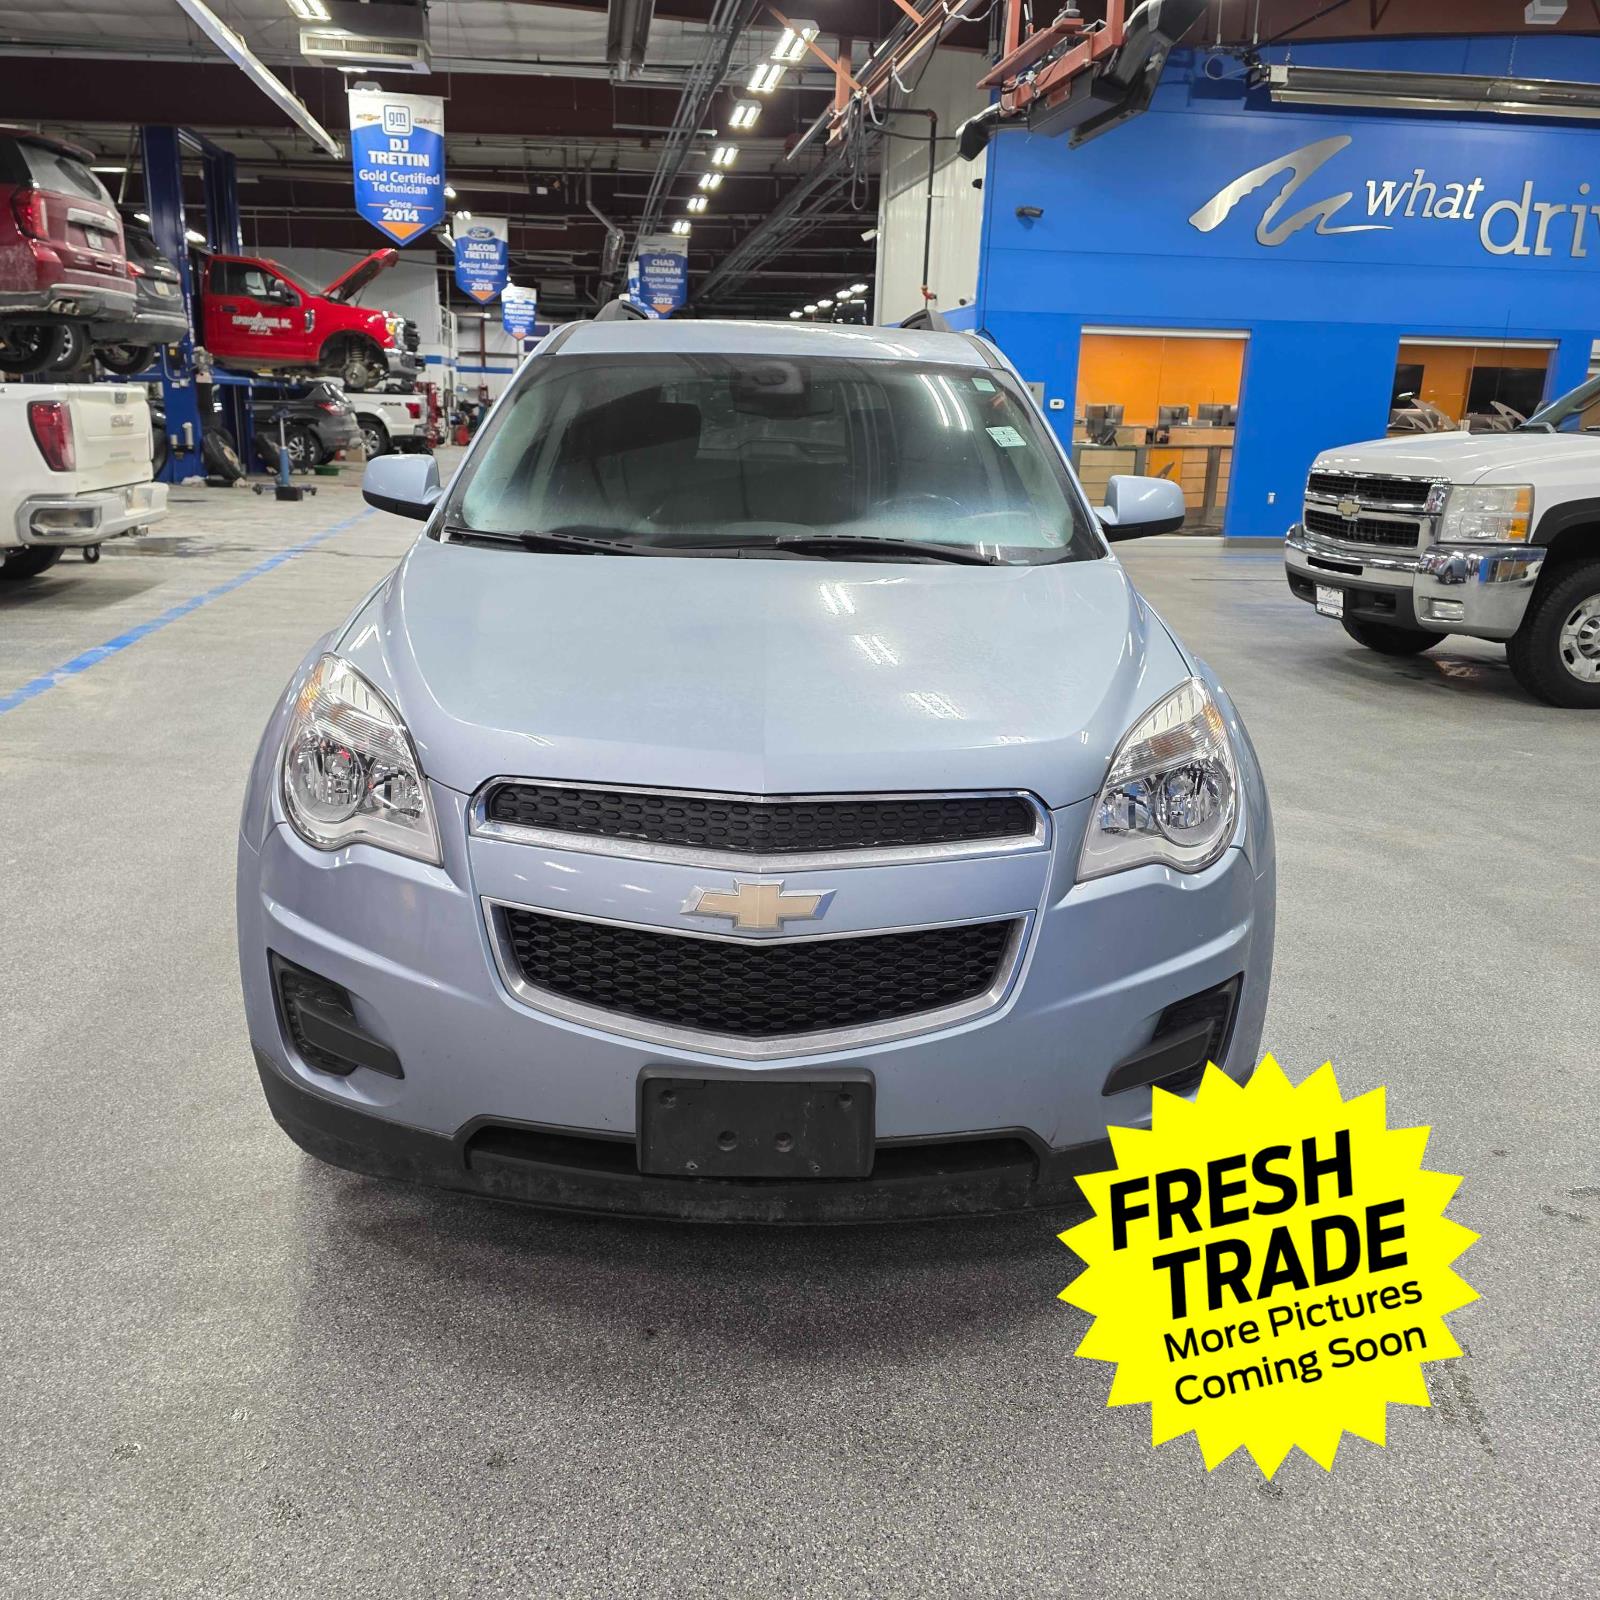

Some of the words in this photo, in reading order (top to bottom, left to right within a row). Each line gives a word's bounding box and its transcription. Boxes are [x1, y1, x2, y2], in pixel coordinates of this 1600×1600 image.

[389, 138, 409, 152] DJ
[367, 150, 430, 167] TRETTIN
[359, 168, 387, 183] Gold
[389, 171, 440, 186] Certified
[372, 181, 428, 195] Technician
[389, 199, 412, 209] Since
[382, 208, 420, 222] 2014
[1365, 169, 1485, 220] what
[1479, 180, 1600, 257] dri
[467, 243, 496, 252] JACOB
[464, 251, 500, 260] TRETTIN
[459, 261, 480, 270] Senior
[481, 263, 505, 271] Master
[645, 266, 682, 275] HERMAN
